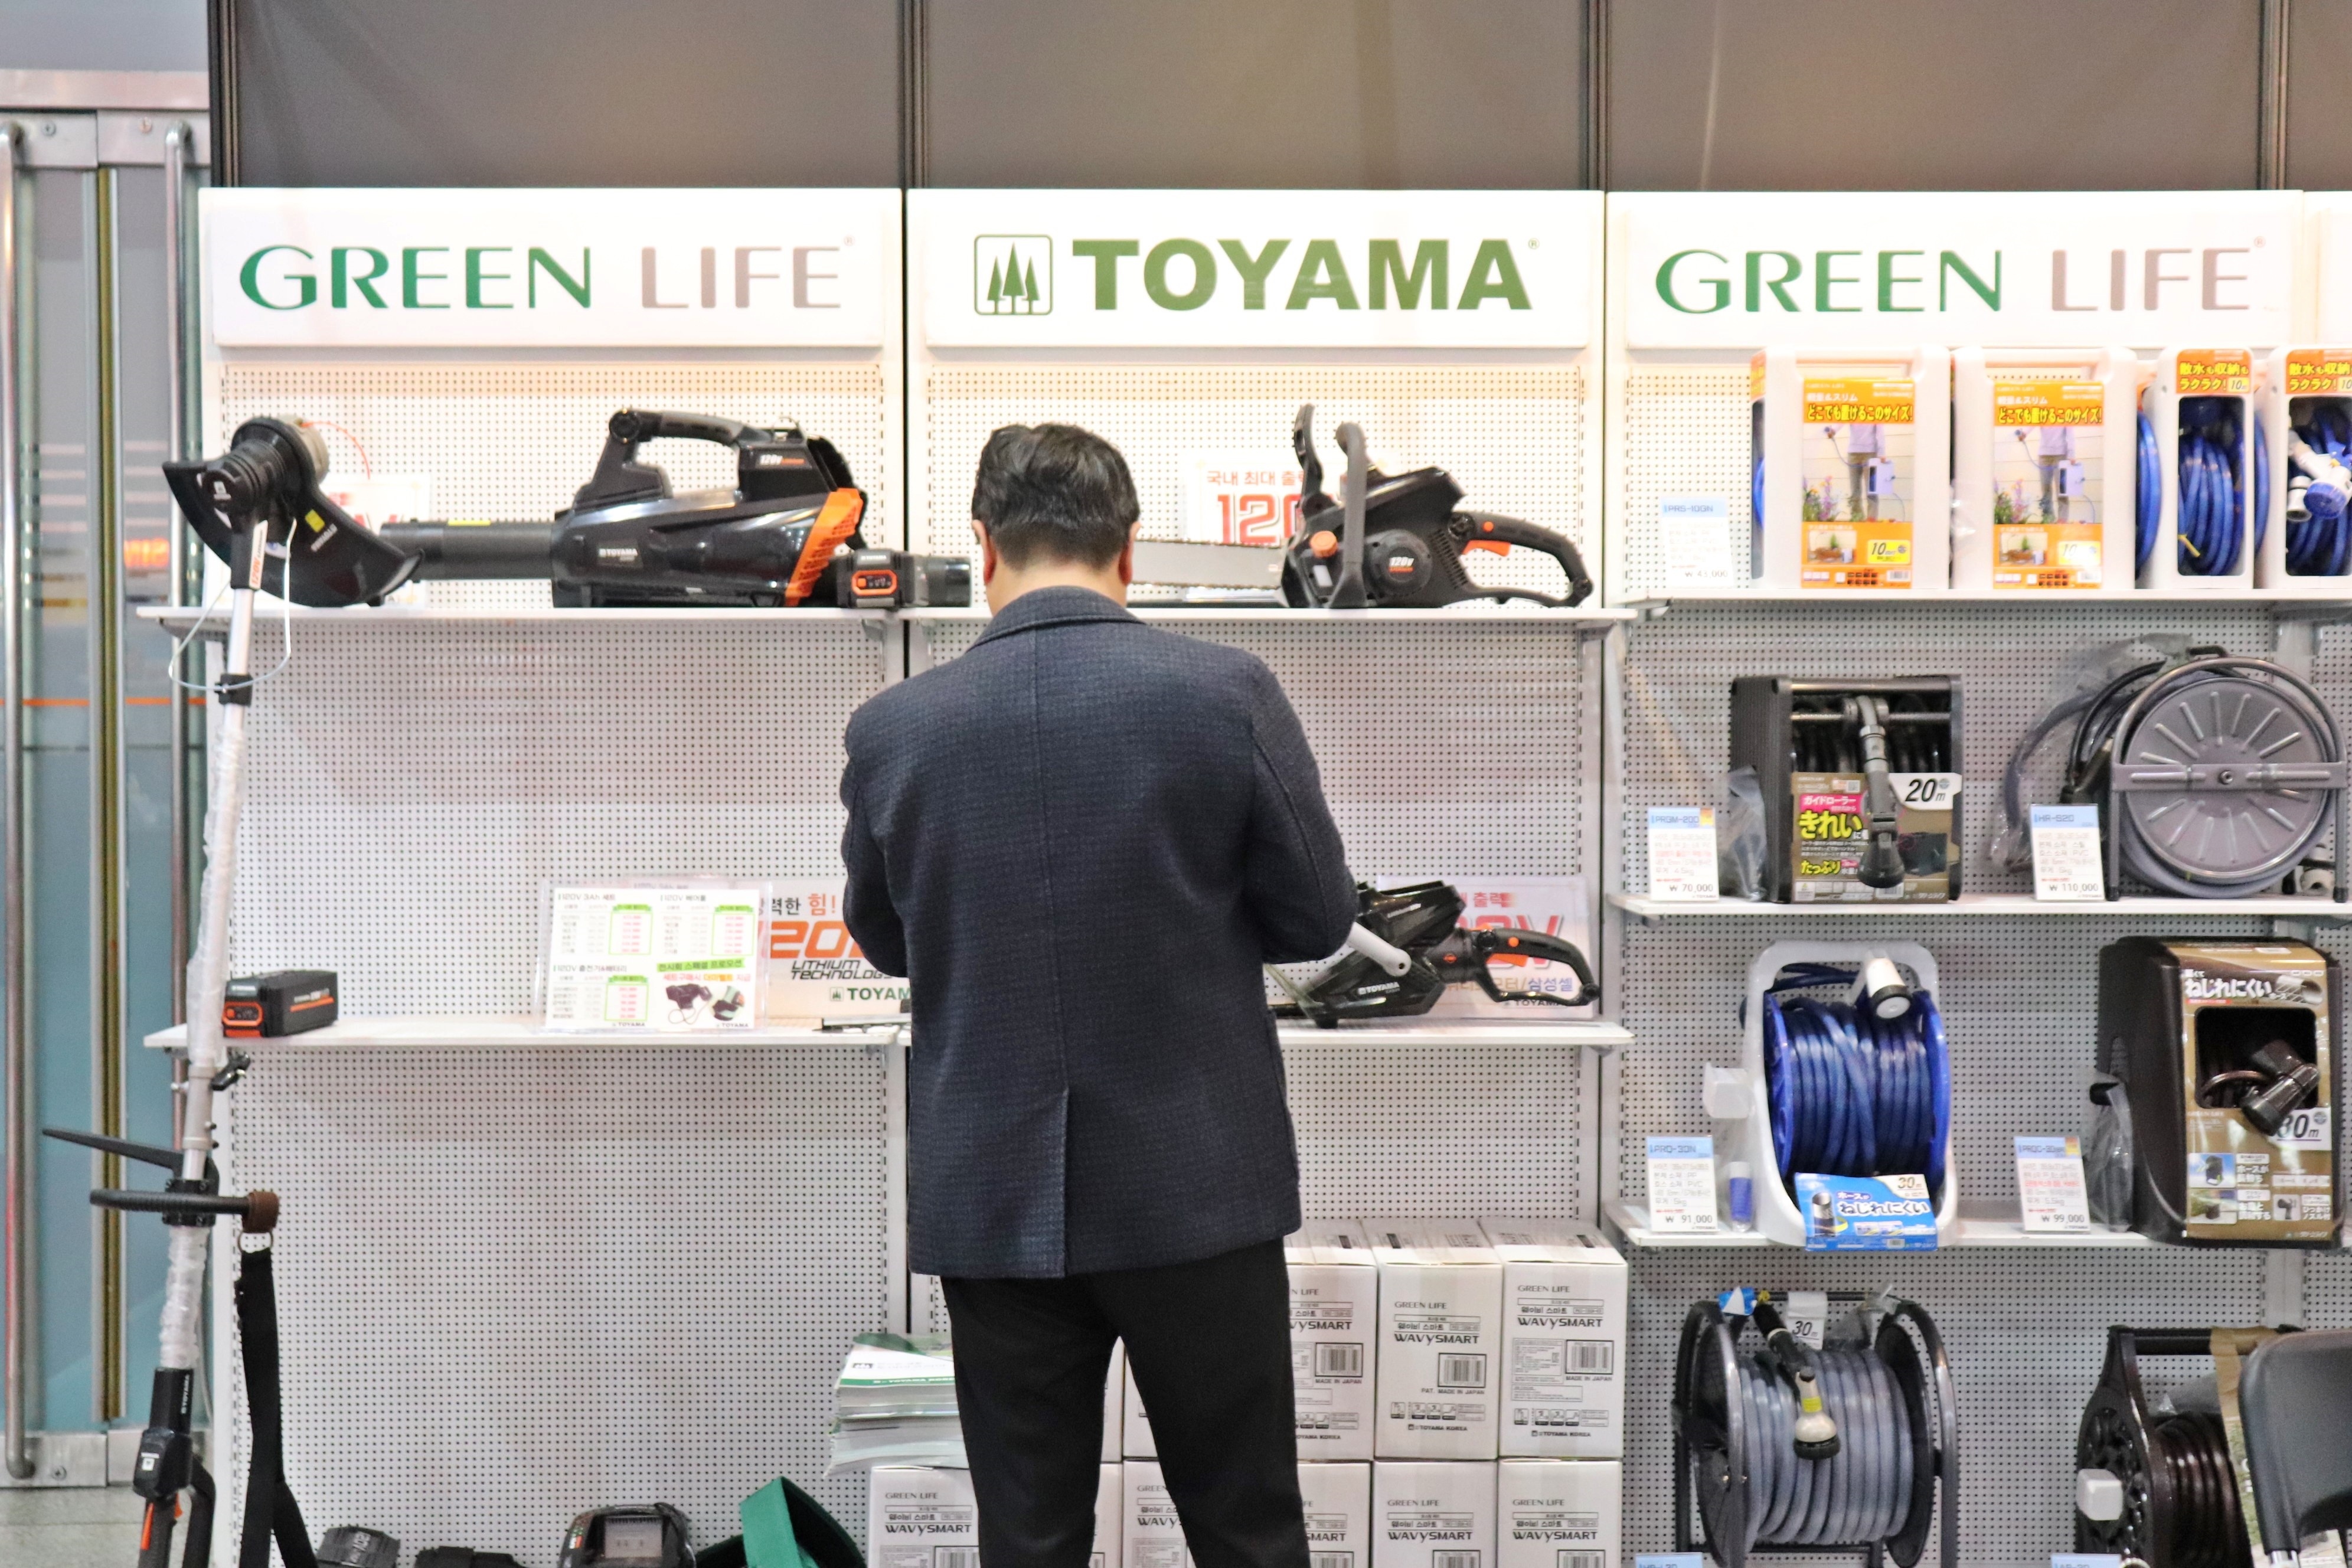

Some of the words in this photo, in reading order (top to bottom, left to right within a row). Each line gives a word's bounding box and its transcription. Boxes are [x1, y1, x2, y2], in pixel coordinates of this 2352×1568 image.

[239, 244, 592, 311] GREEN
[641, 246, 841, 309] LIFE
[1072, 238, 1533, 311] TOYAMA
[1655, 249, 2003, 314] GREEN
[2052, 248, 2250, 312] LIFE
[2289, 362, 2352, 375] 散水も収納
[1807, 403, 1913, 421] どこでも置けるこのサイズ!
[1997, 407, 2102, 424] どこでも置けるこのサイズ!
[1207, 471, 1238, 486] 국내
[1244, 471, 1275, 486] 최대
[606, 548, 638, 557] TOYAMA
[1697, 570, 1728, 579] 43,000
[1804, 796, 1856, 805] ガイドローラー
[1799, 809, 1863, 839] きれい
[1801, 860, 1841, 874] たっぷり
[1683, 884, 1713, 893] 70,000
[2063, 883, 2098, 893] 110,000
[1366, 982, 1400, 992] TOYAMA
[2185, 978, 2272, 998] ねじれにくい
[847, 988, 912, 1000] TOYAM
[1837, 1201, 1930, 1216] ねじれにくい
[1681, 1215, 1713, 1224] 91,000
[2053, 1214, 2085, 1223] 99,000
